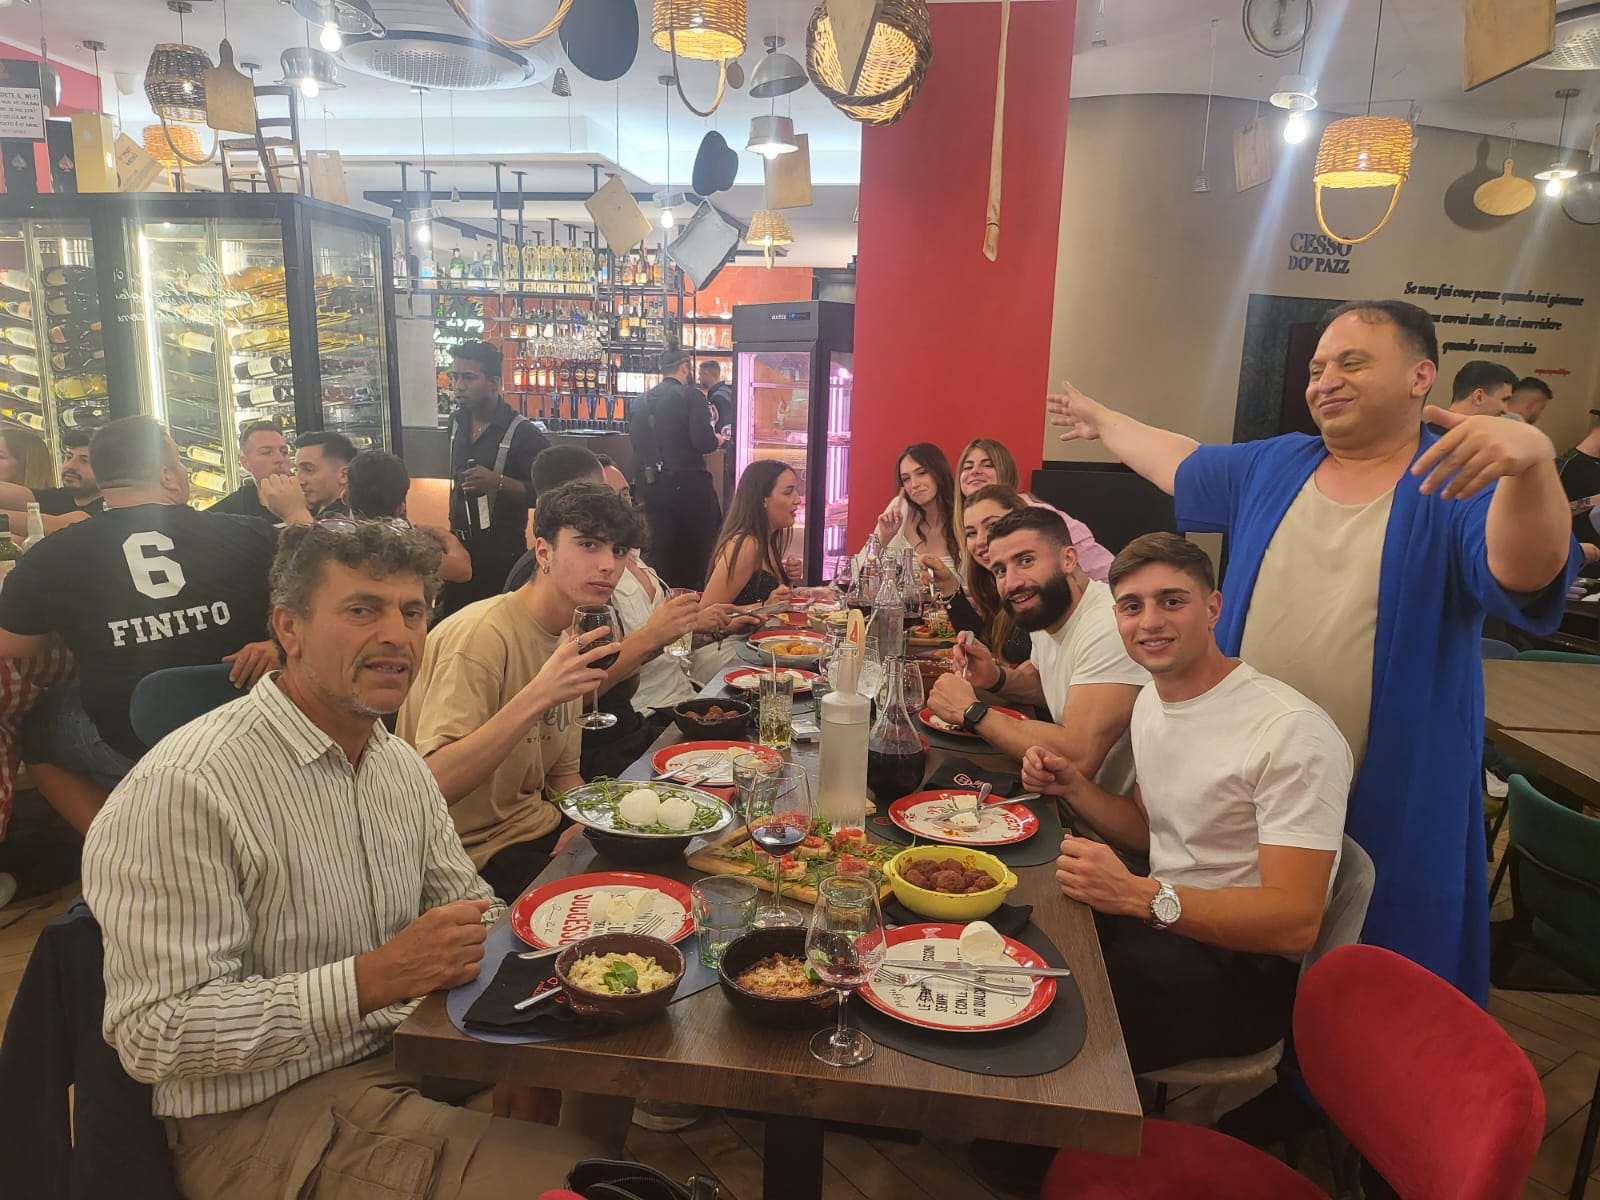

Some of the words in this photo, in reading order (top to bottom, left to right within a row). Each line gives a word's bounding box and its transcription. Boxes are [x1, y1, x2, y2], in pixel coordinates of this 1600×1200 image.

[1290, 232, 1353, 257] CESSO
[1314, 257, 1350, 274] PAZZ
[1404, 281, 1418, 295] Se
[1434, 283, 1454, 300] fai
[122, 531, 186, 599] 6
[107, 600, 231, 647] FINITO
